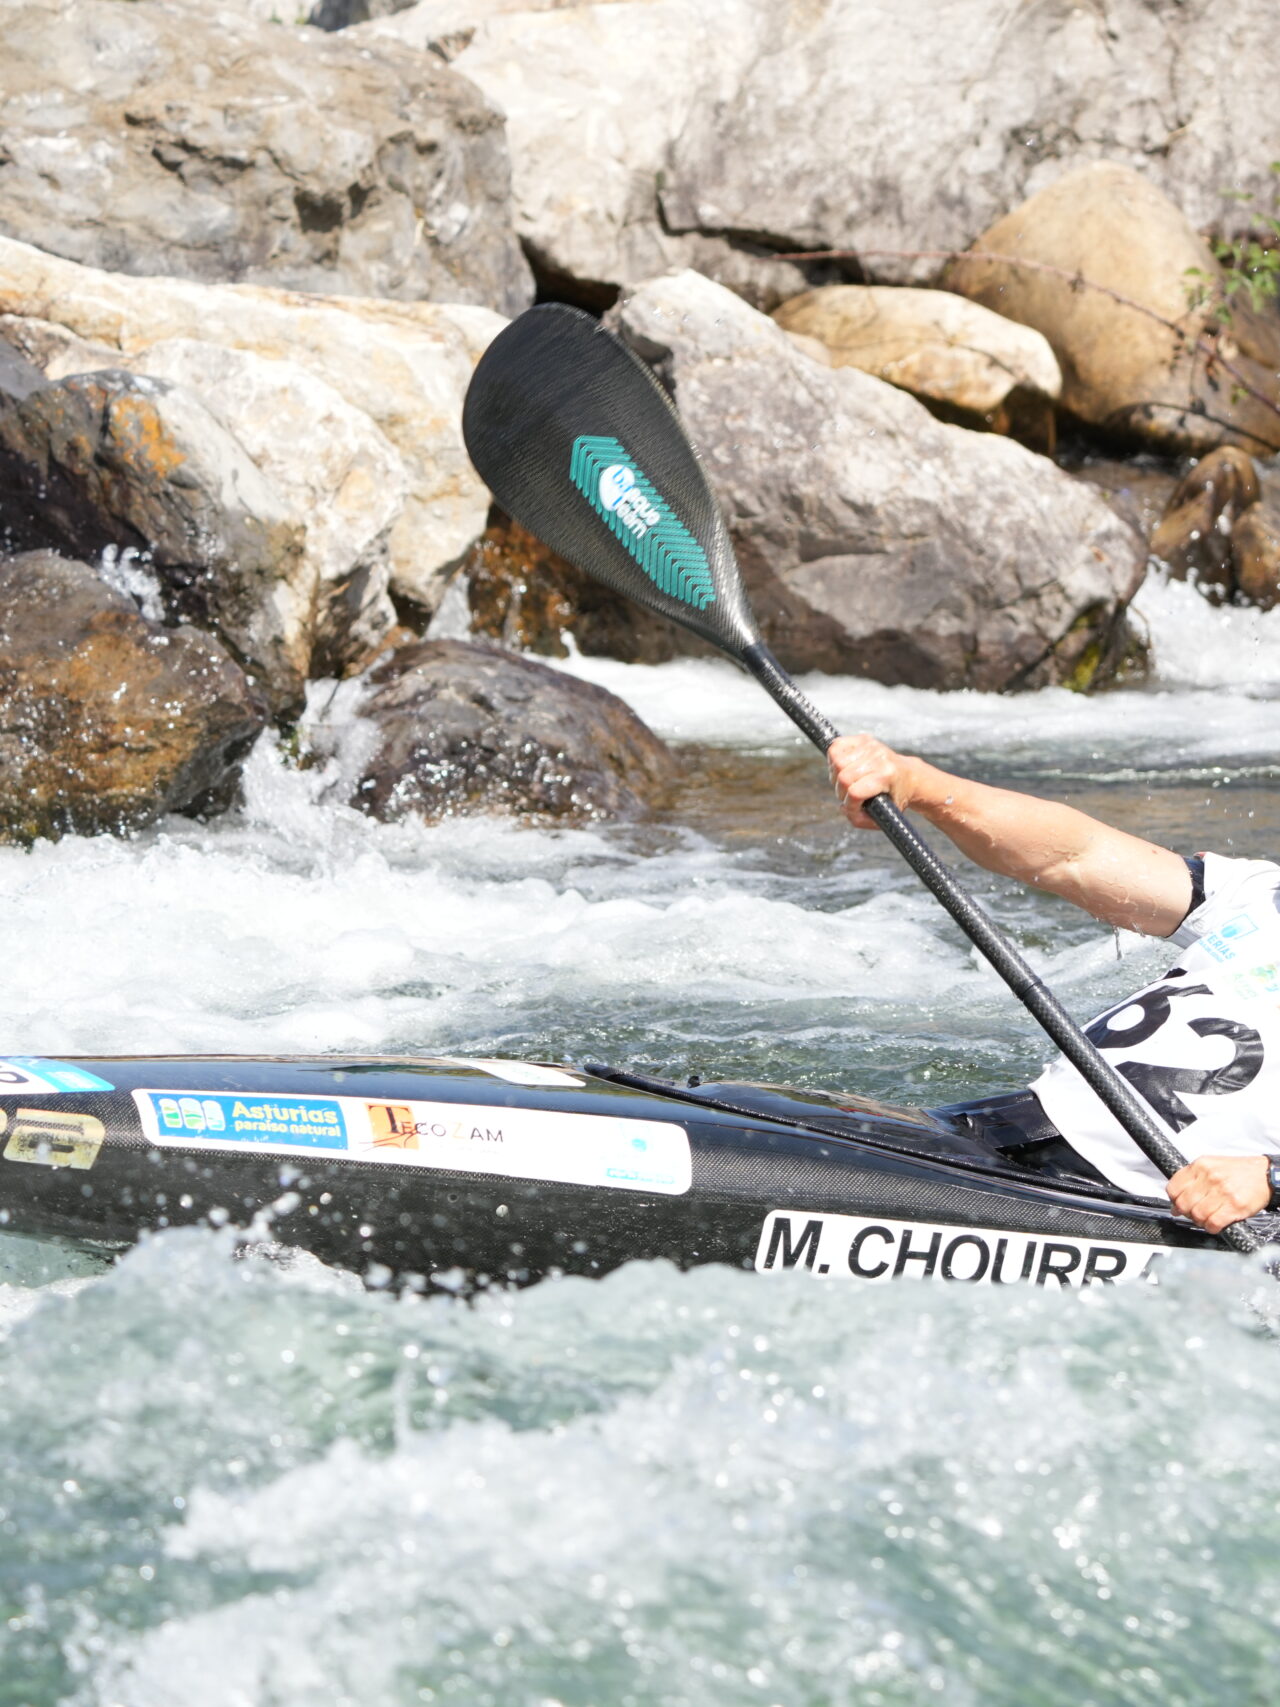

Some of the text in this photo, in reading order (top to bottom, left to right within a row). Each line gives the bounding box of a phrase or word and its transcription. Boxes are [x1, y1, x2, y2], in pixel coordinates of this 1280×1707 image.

[232, 1101, 339, 1125] Asturias
[234, 1119, 342, 1137] paraíso natural
[763, 1217, 830, 1275] M.
